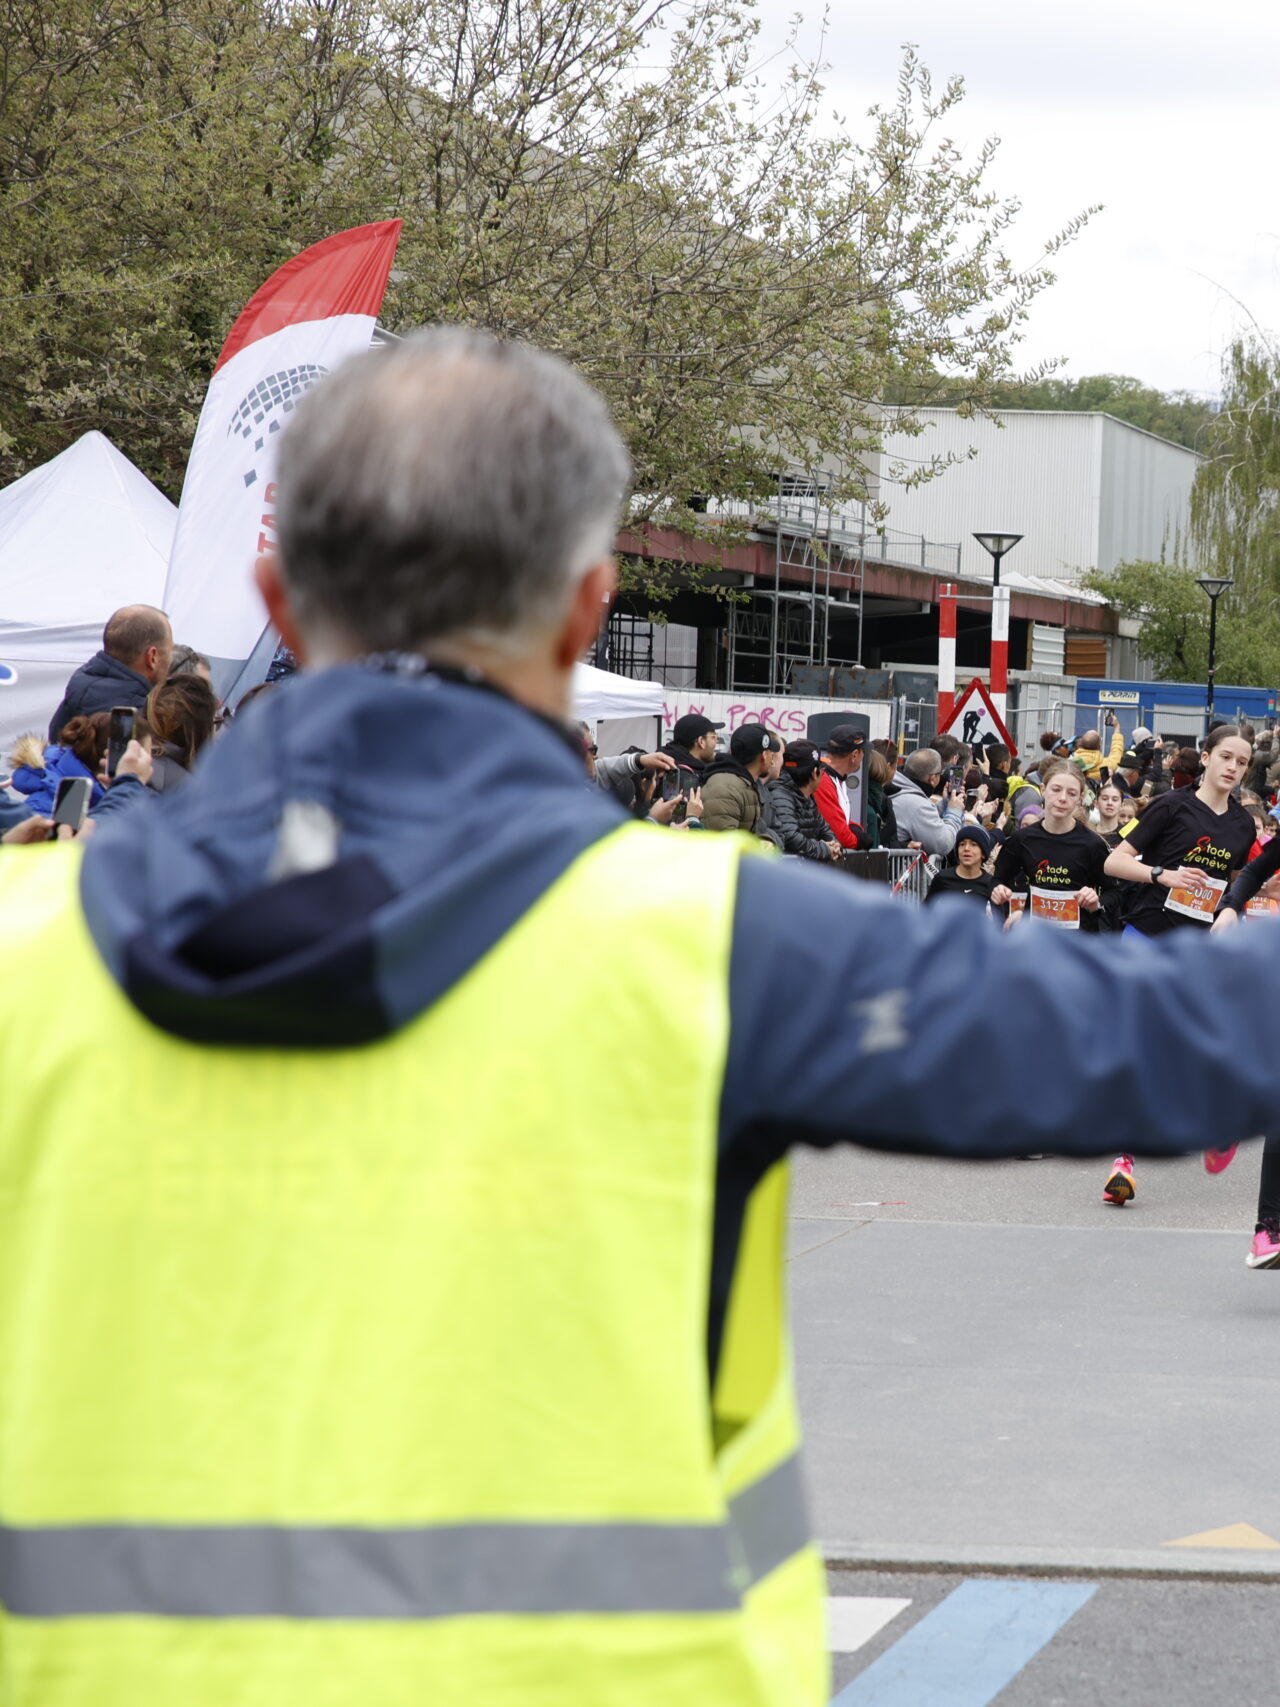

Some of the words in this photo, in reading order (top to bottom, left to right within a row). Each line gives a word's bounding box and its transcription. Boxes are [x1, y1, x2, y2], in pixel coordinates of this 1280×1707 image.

[727, 704, 806, 732] PORCS
[1188, 836, 1232, 860] Stade
[1035, 860, 1069, 875] Stade
[1040, 899, 1066, 911] 3127
